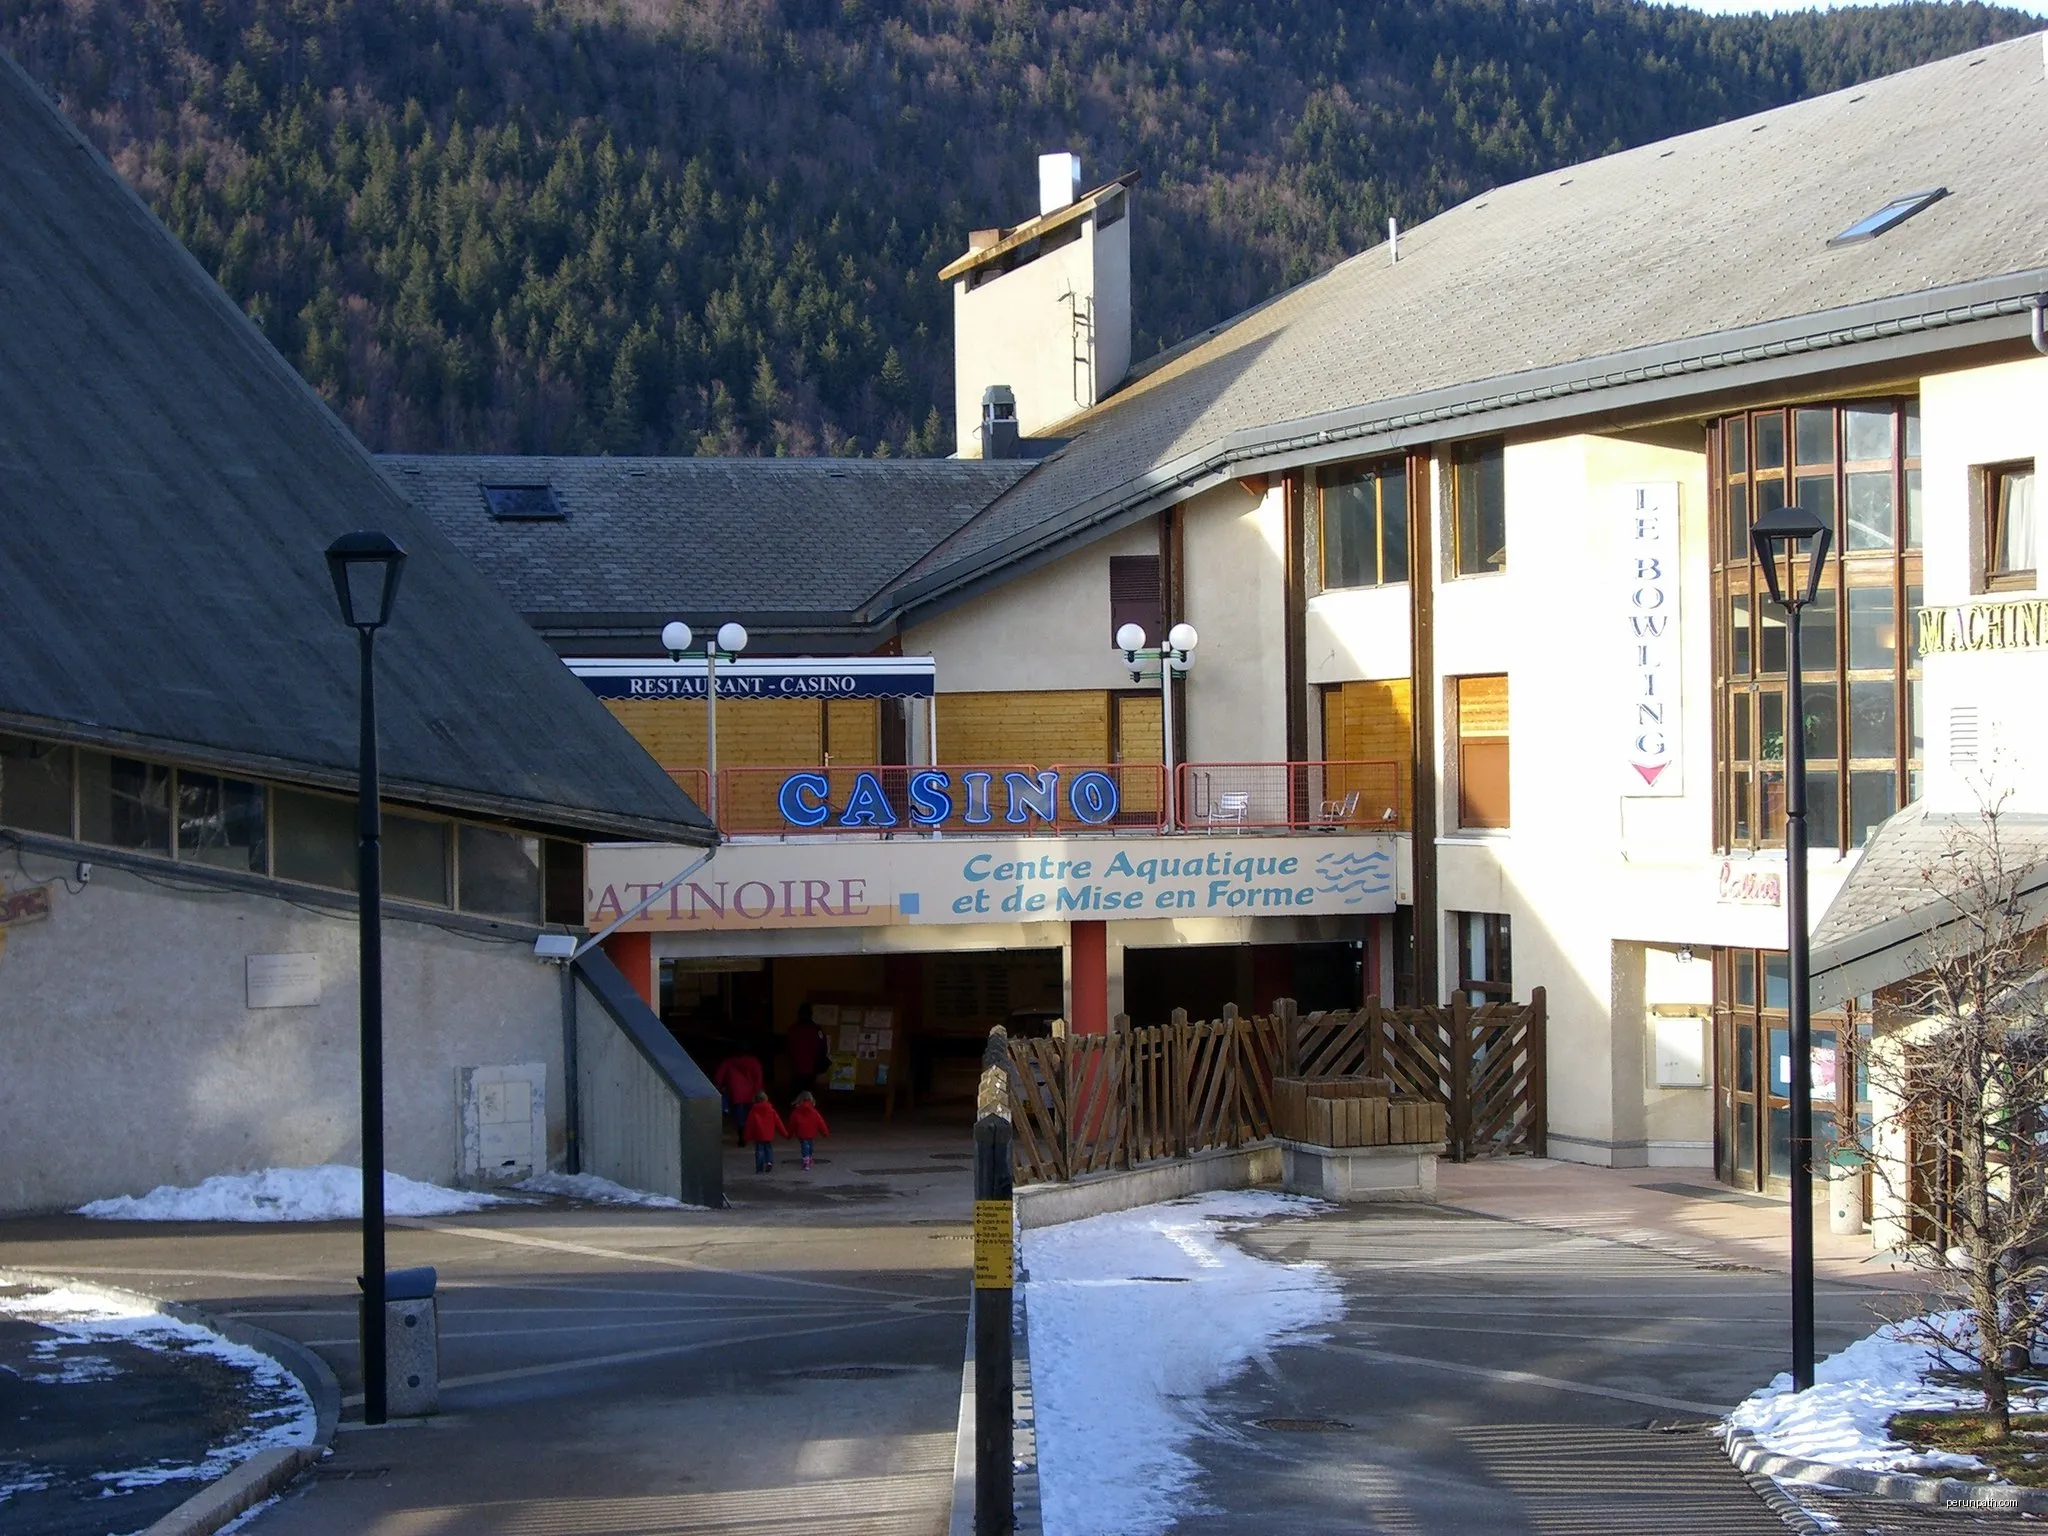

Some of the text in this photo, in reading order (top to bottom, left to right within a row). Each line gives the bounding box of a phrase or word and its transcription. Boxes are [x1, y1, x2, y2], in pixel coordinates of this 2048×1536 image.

[1628, 557, 1668, 756] BOWLING
[630, 677, 763, 694] RESTAURANT
[780, 675, 856, 693] CASINO
[778, 770, 1120, 827] CASINO
[963, 850, 1298, 885] Centre Aquatique
[588, 878, 871, 922] ATINOIRE
[952, 880, 1314, 914] et de Mise en Forme
